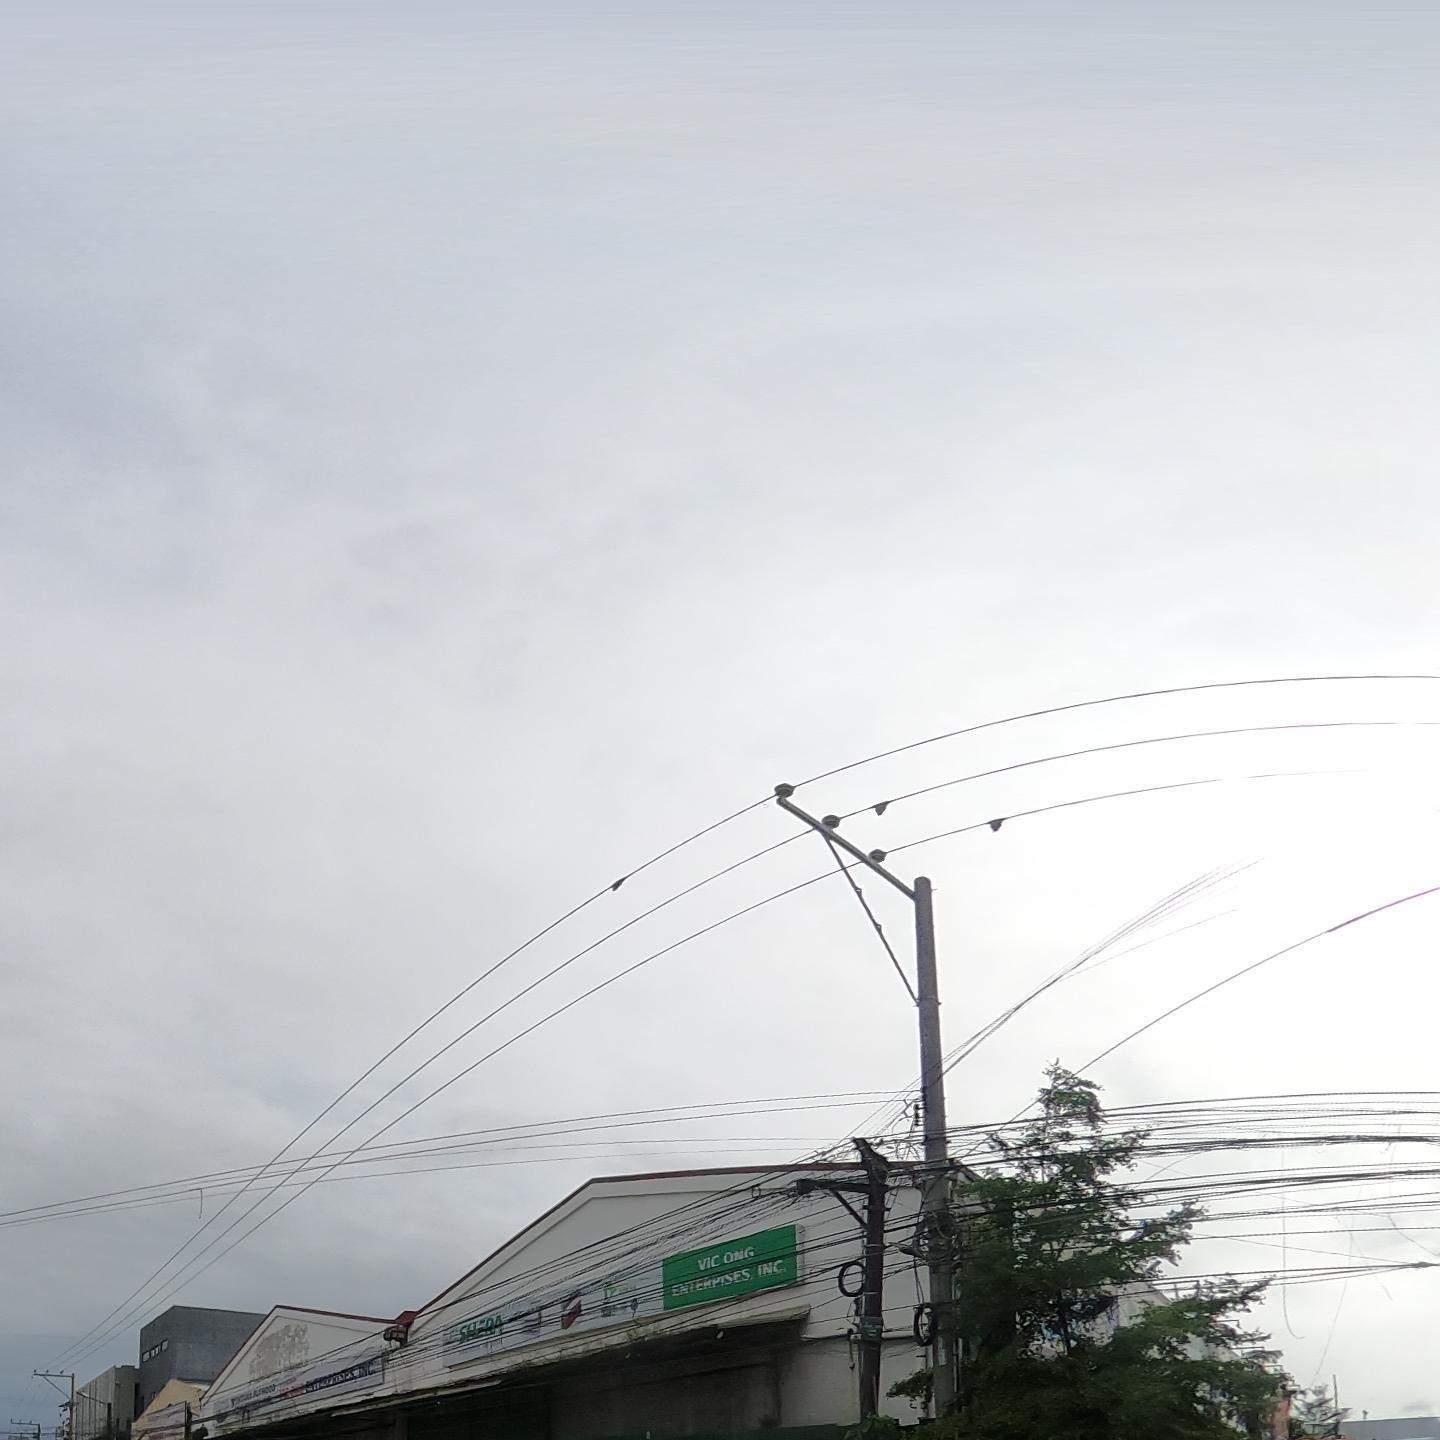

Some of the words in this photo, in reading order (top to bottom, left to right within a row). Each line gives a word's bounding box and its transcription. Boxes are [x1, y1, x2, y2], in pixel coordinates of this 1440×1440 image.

[698, 1255, 720, 1271] VIC
[723, 1246, 755, 1265] ONG
[758, 1259, 787, 1277] INC.
